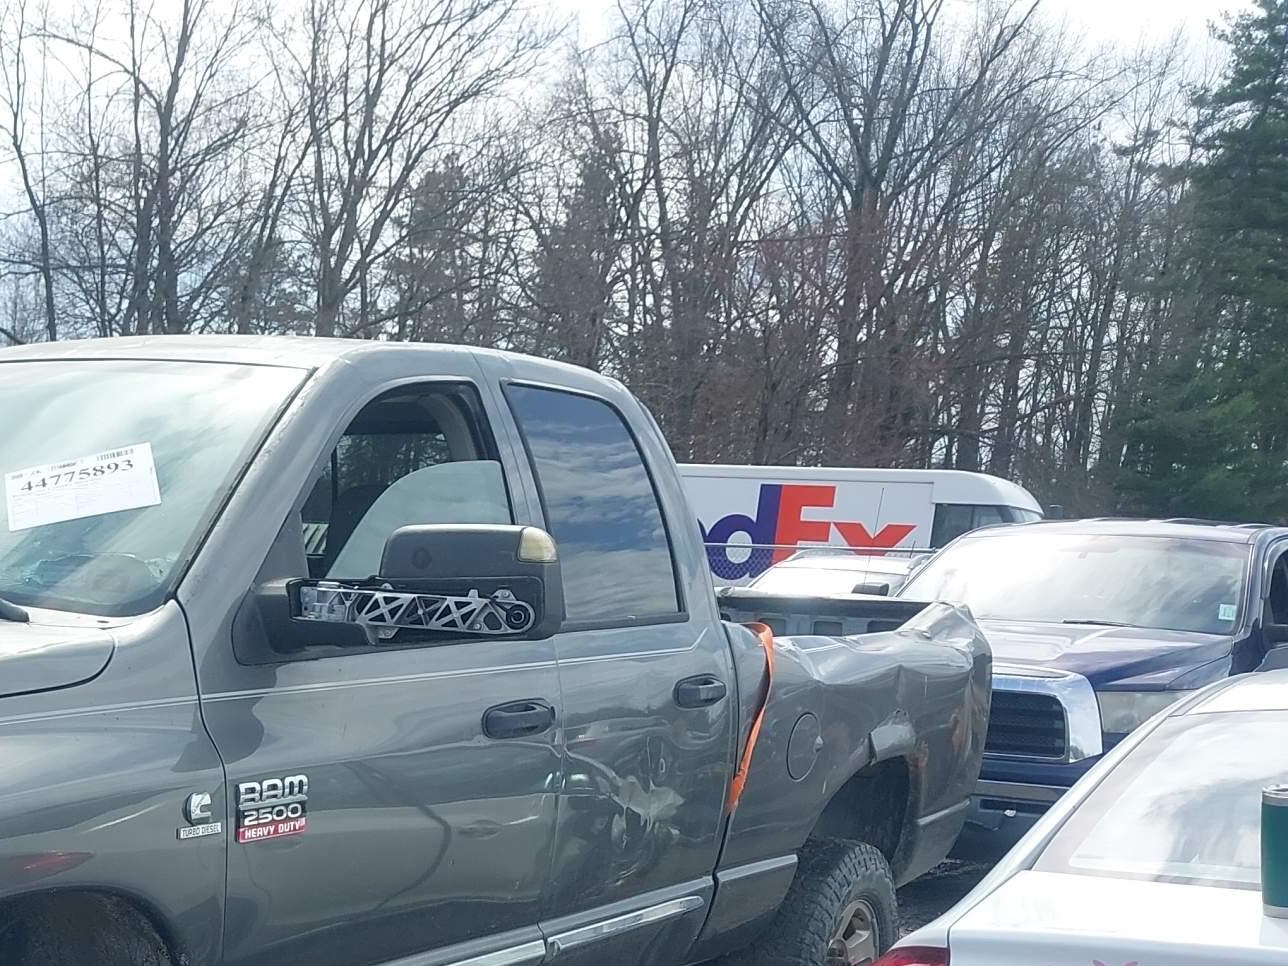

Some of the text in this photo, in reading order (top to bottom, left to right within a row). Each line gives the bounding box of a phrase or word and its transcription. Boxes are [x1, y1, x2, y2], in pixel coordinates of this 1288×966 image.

[20, 459, 134, 491] 44775893
[697, 484, 917, 580] dEx
[239, 774, 308, 805] RAM
[244, 803, 302, 826] 2500
[245, 820, 301, 839] HEAVY DUTY
